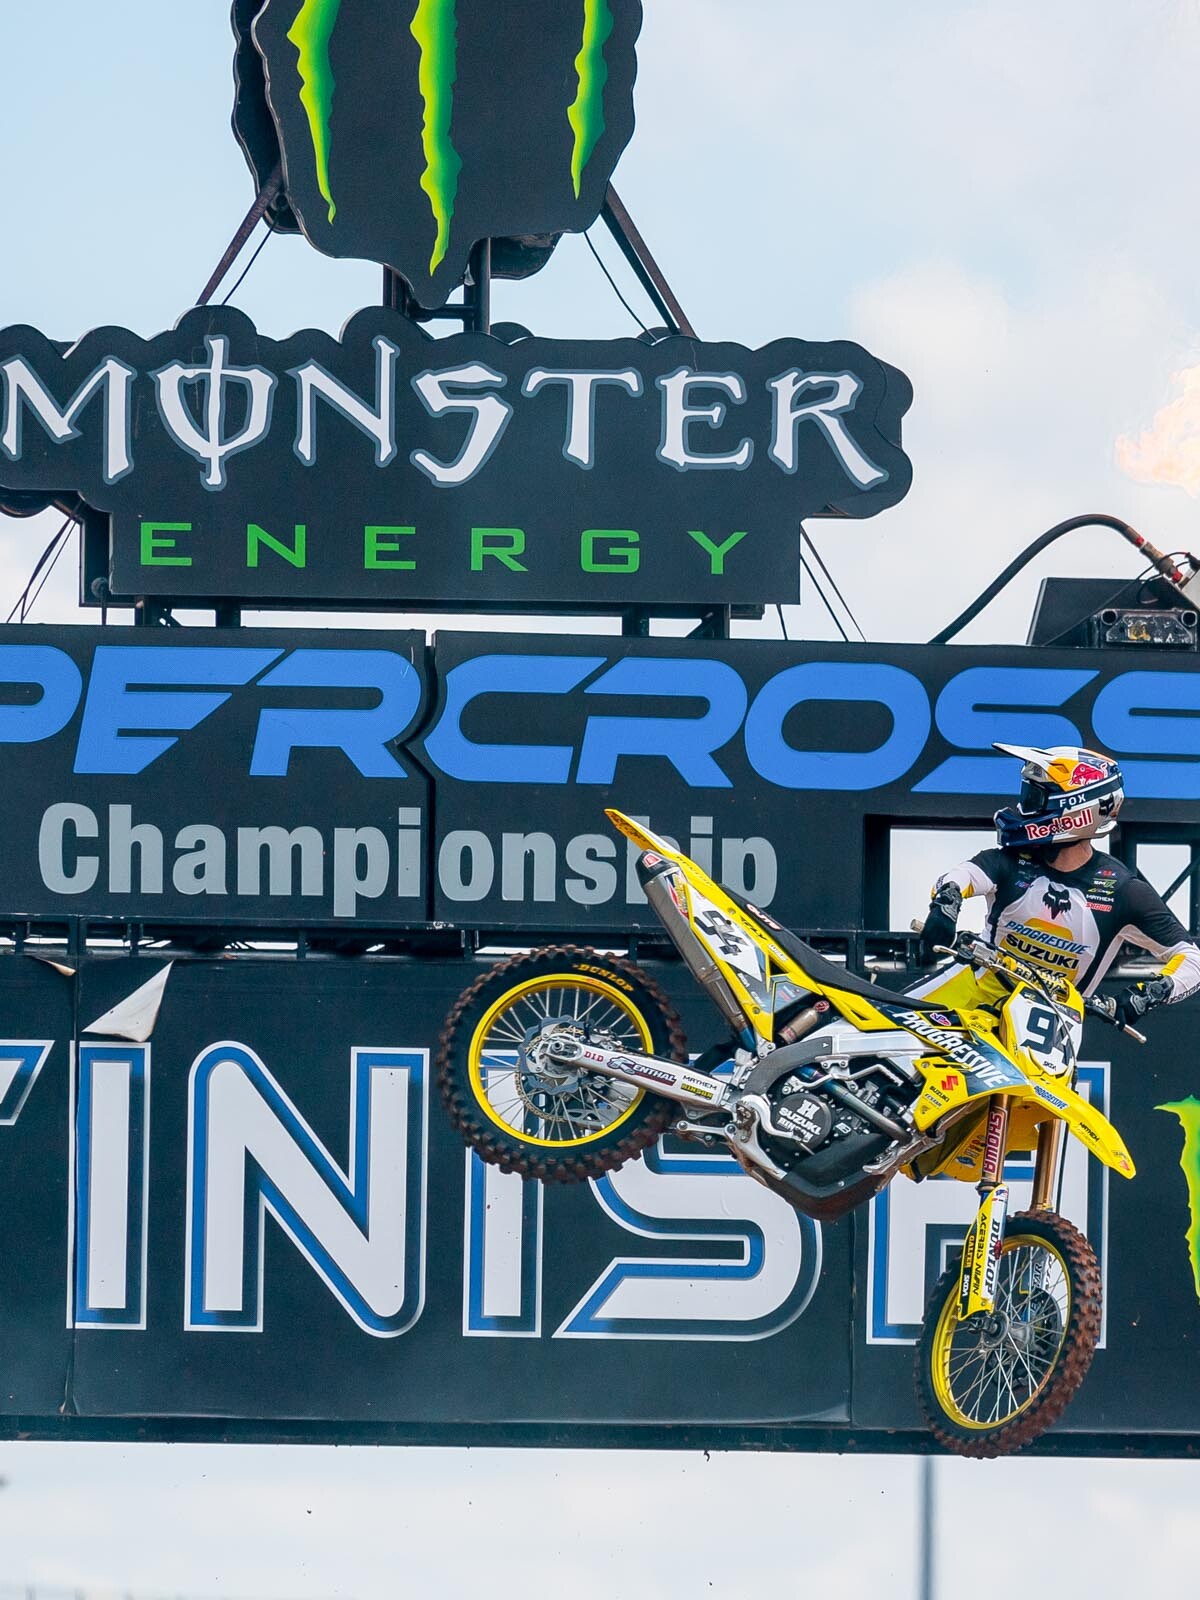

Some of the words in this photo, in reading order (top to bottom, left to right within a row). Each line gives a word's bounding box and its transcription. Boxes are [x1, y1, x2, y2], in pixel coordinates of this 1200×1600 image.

[2, 335, 889, 490] MONSTER
[140, 521, 748, 576] ENERGY
[1059, 794, 1087, 808] FOX
[1005, 920, 1092, 954] PROGRESSIVE
[1005, 933, 1080, 970] SUZUKI
[892, 1010, 1011, 1089] PROGRESSIVE
[682, 1074, 718, 1091] MAYHEM
[929, 1085, 951, 1103] SUZUKI
[779, 1107, 822, 1136] SUZUKI
[983, 1111, 1002, 1174] SHOWA
[983, 1218, 1001, 1297] DUNLOP
